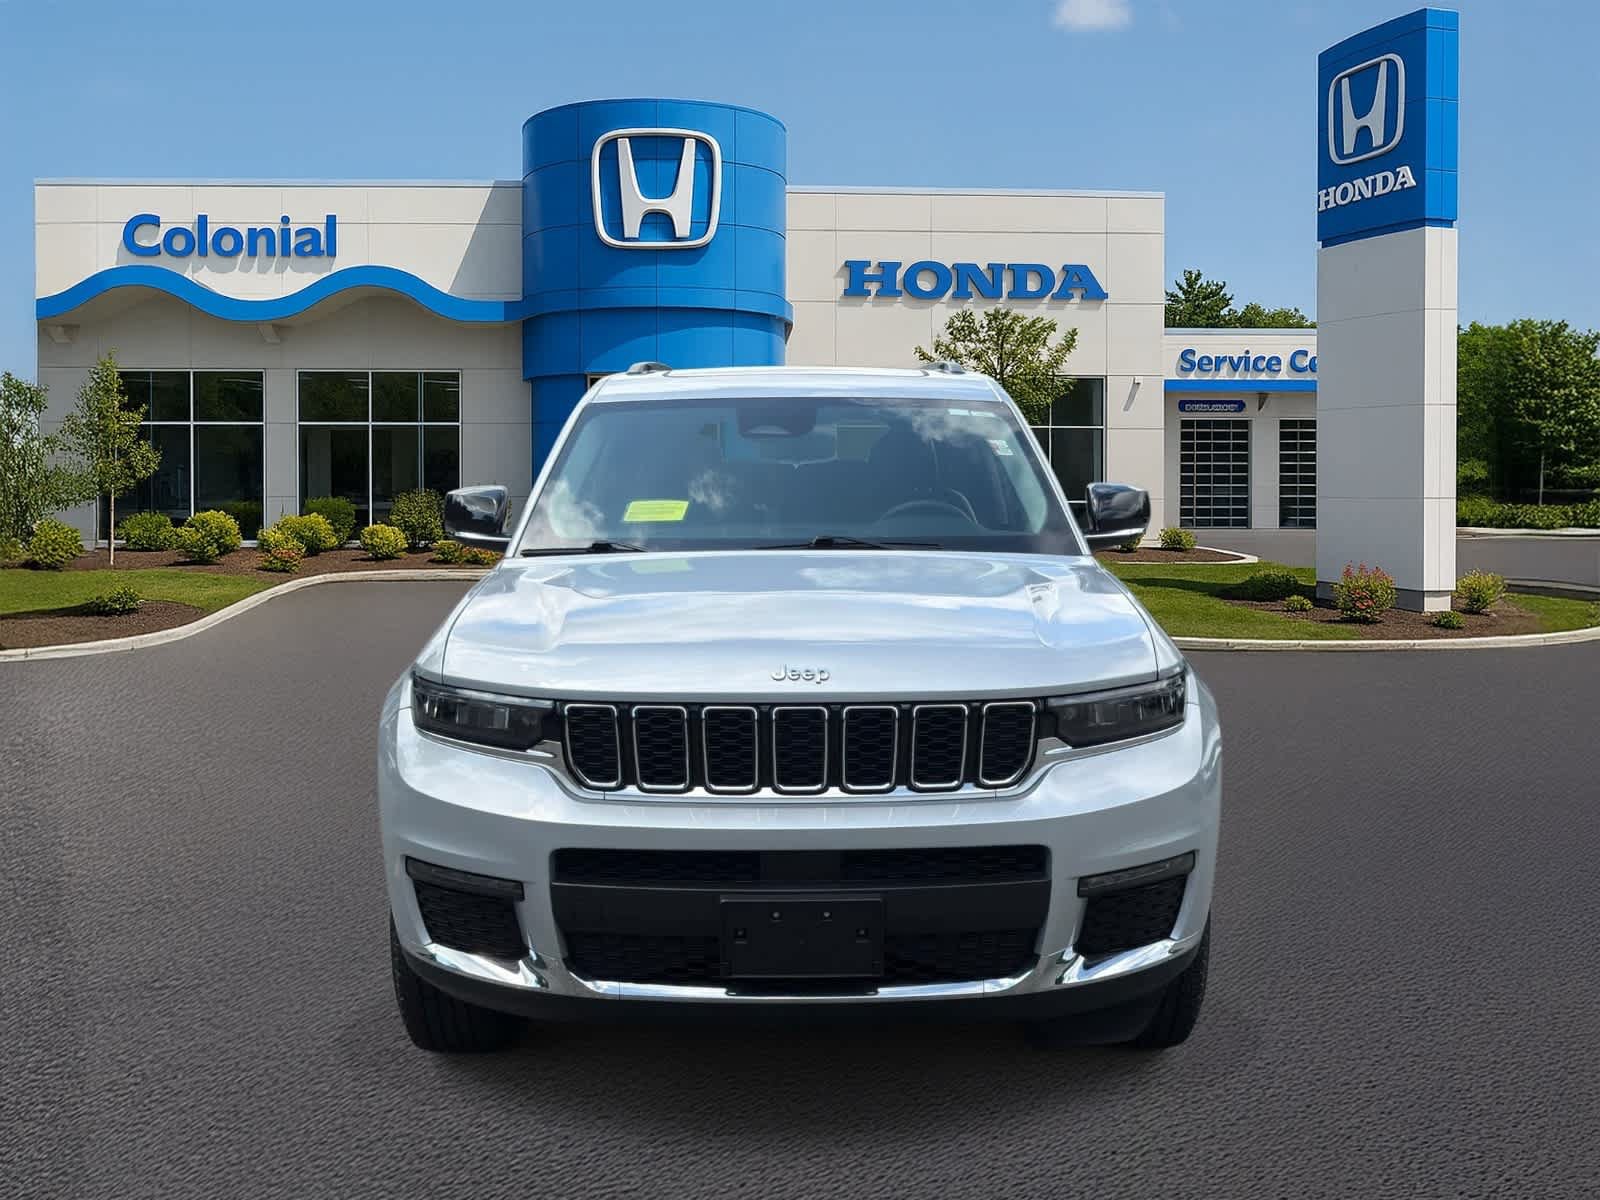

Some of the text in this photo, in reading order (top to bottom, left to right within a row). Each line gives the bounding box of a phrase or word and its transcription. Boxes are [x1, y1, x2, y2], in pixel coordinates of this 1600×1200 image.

[1318, 166, 1416, 212] HONDA
[123, 213, 337, 258] Colonial
[843, 260, 1109, 300] HONDA
[1180, 349, 1282, 373] Service
[770, 663, 831, 685] Jeep
